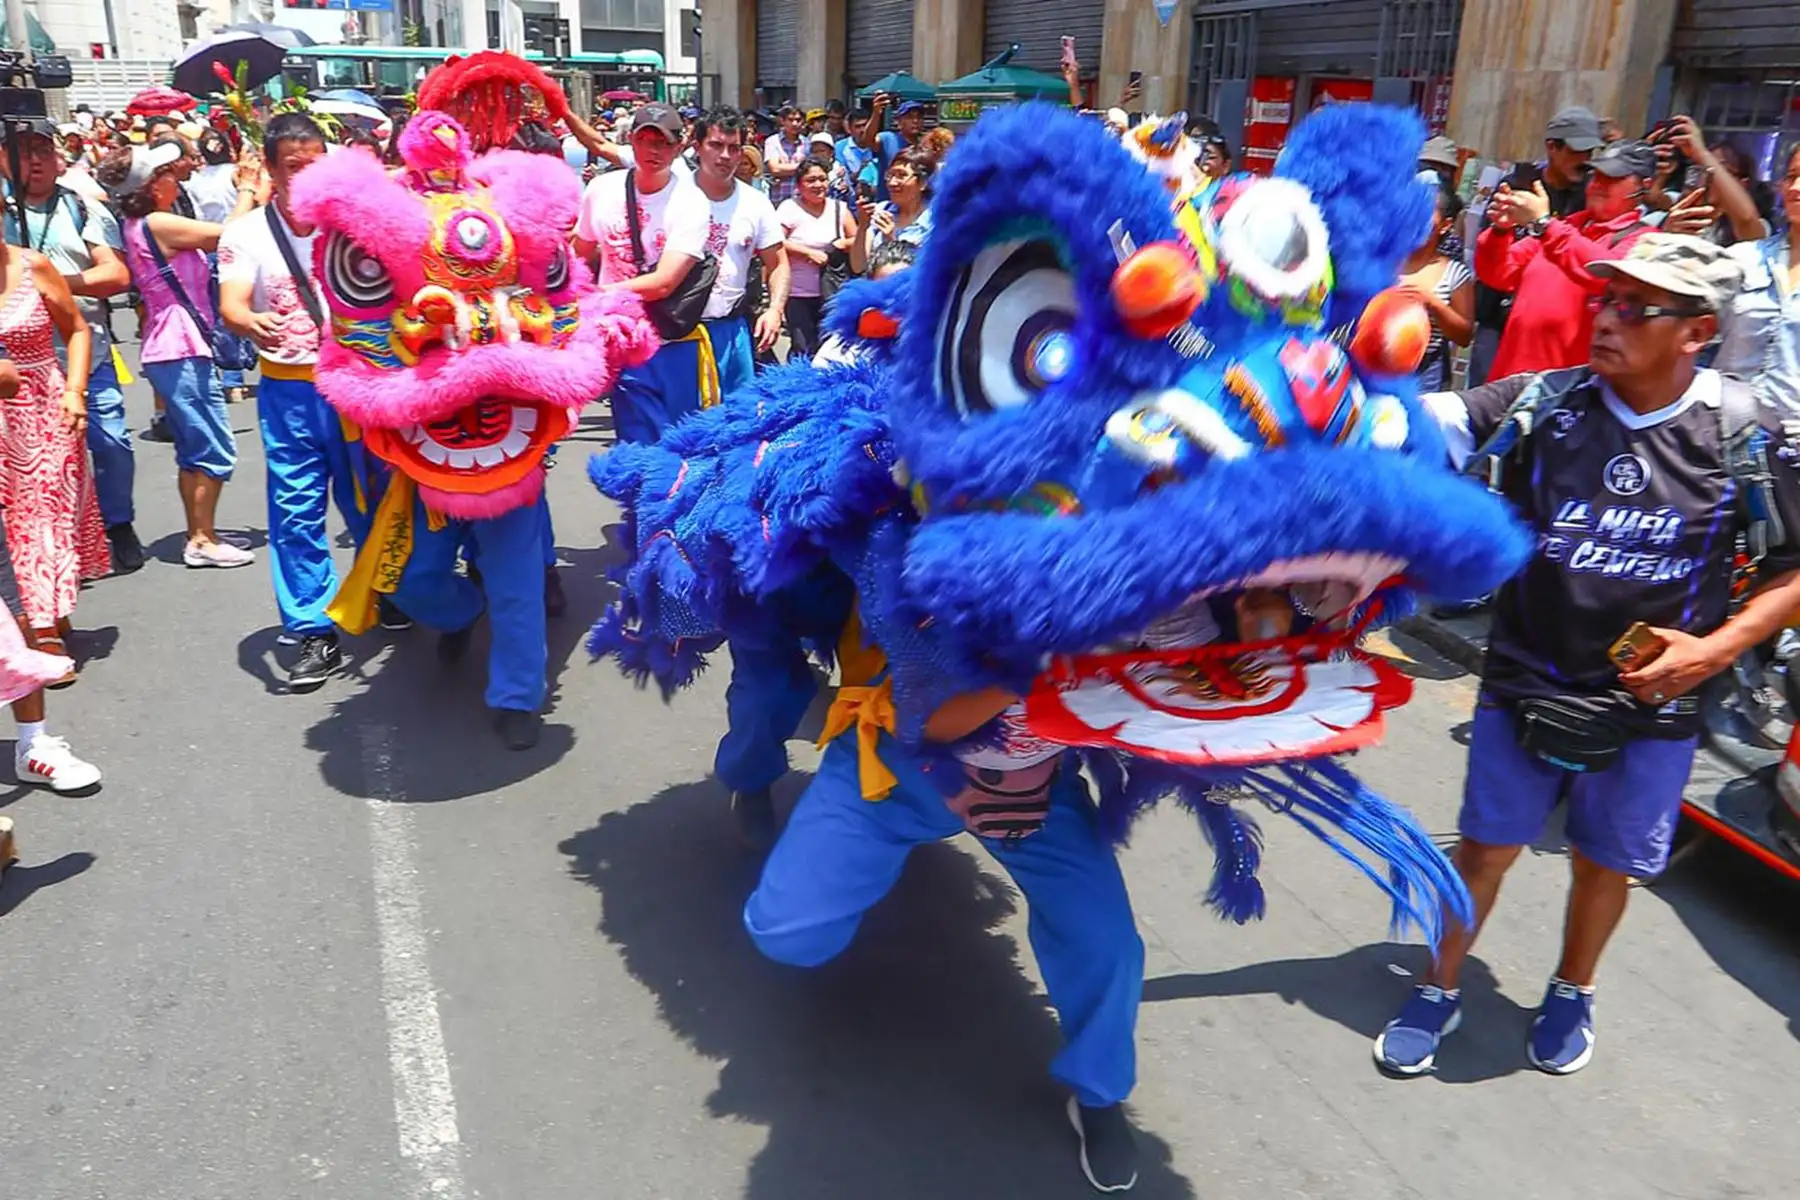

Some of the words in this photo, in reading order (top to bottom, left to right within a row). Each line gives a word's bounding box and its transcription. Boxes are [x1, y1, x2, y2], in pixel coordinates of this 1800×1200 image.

[1553, 501, 1590, 528] LA
[1596, 508, 1682, 544] MAFÍA
[1569, 541, 1693, 581] CENTENO
